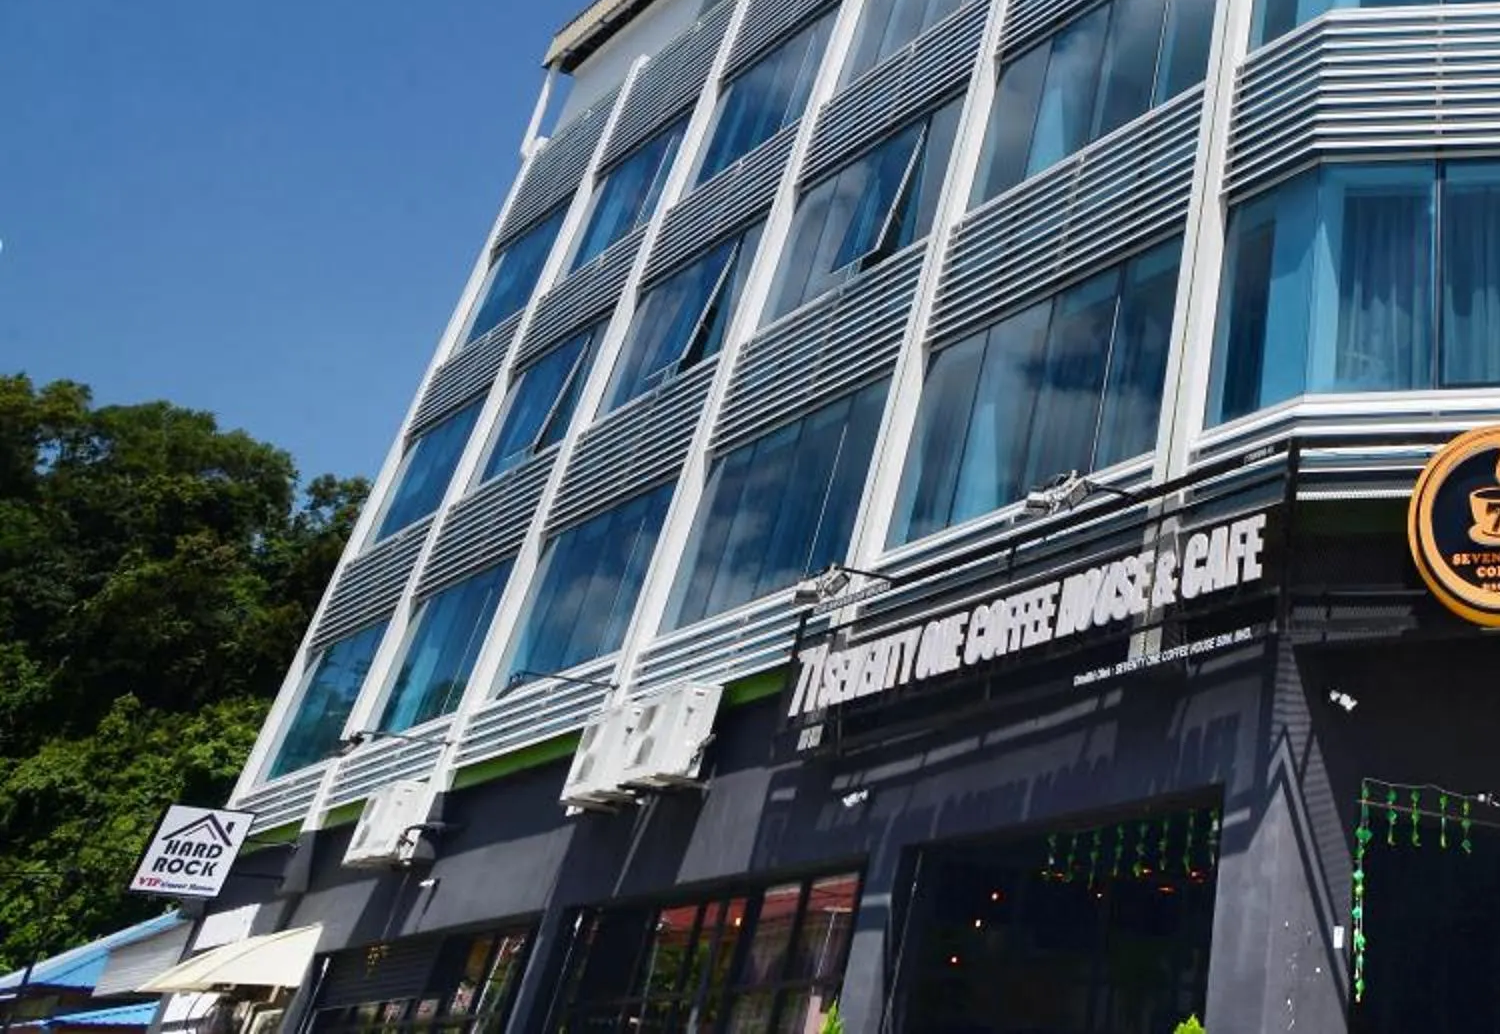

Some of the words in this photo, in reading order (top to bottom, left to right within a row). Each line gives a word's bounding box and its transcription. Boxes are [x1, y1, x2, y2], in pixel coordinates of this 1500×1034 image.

[787, 643, 830, 717] 71
[817, 626, 923, 709] SEVENTY
[915, 611, 971, 680] ONE
[964, 581, 1060, 664] COFFEE
[1054, 550, 1155, 638] HOUSE
[1151, 550, 1178, 607] &
[1181, 513, 1267, 599] CAFE
[164, 839, 223, 858] HARD
[152, 857, 217, 876] ROCK
